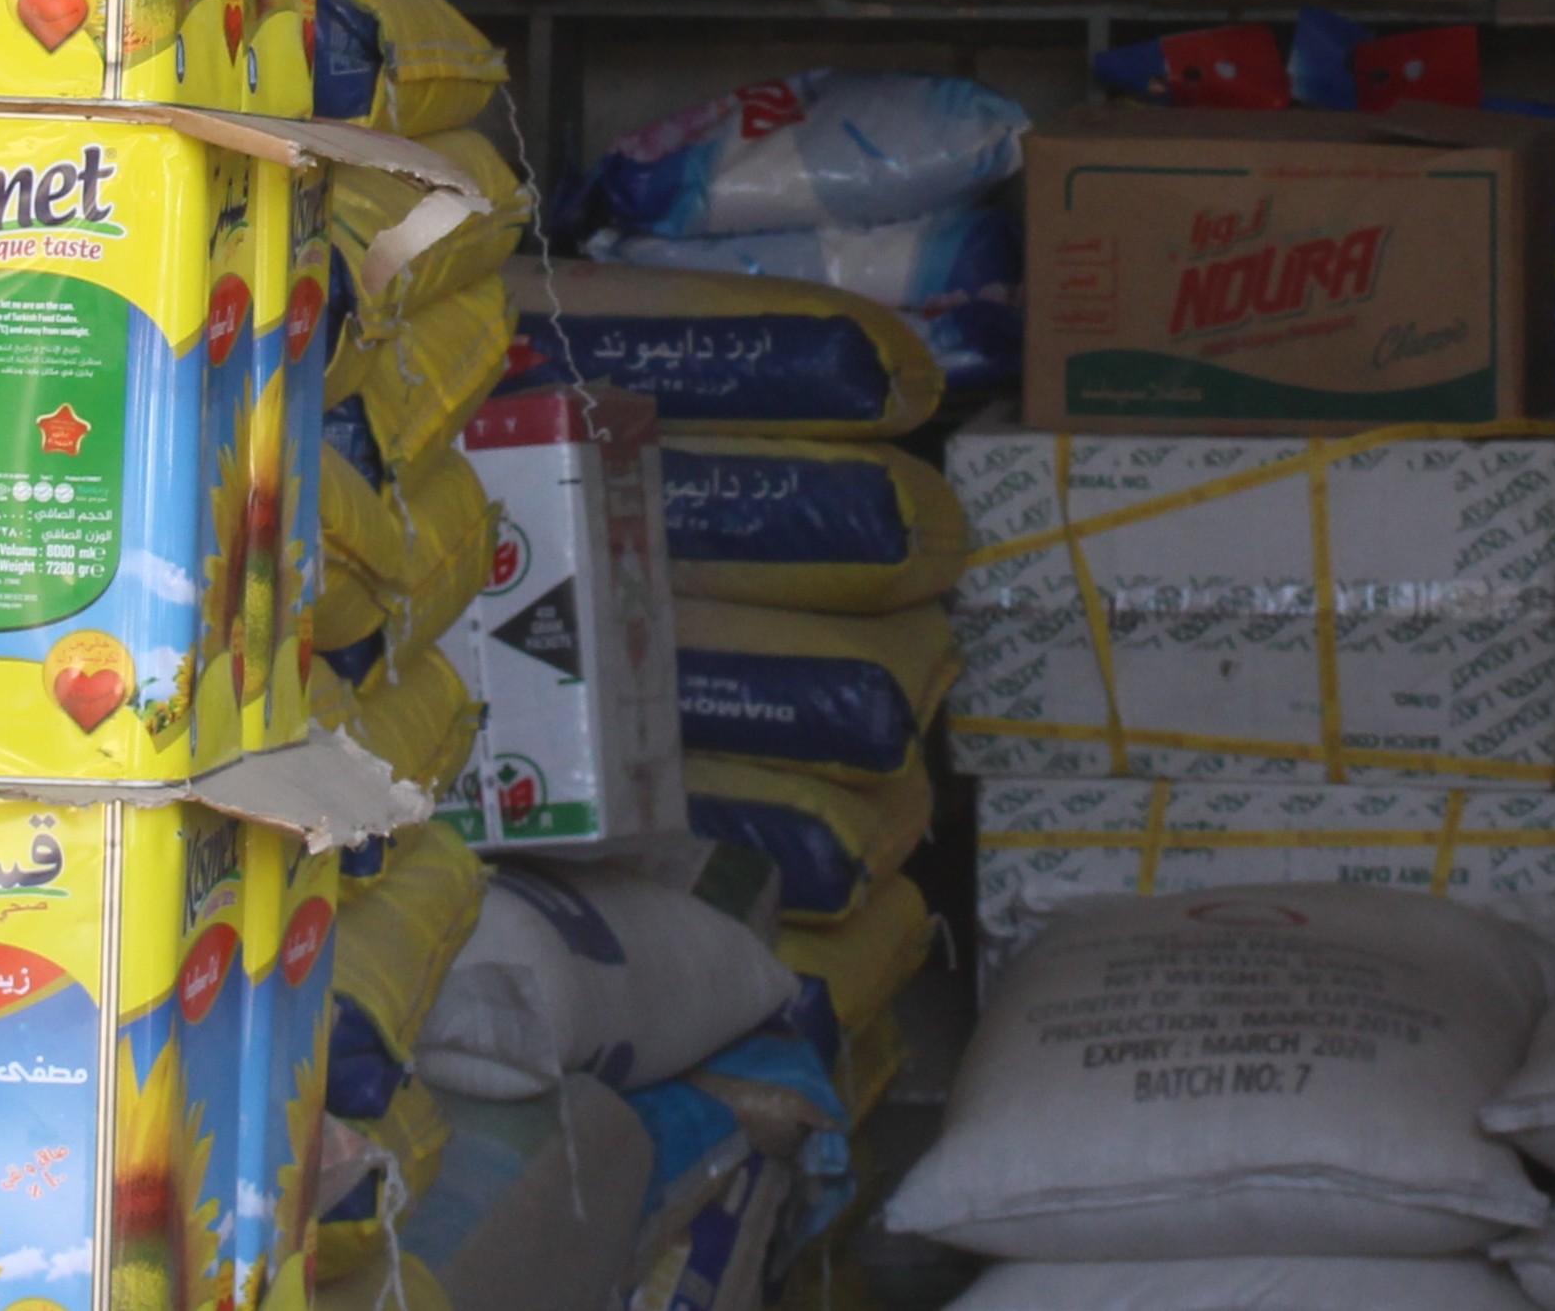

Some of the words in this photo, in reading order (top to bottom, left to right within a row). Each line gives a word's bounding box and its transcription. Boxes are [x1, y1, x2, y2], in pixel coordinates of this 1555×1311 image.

[43, 237, 102, 261] taste
[1169, 226, 1386, 336] NOURA
[593, 328, 715, 370] دايموند
[1082, 1037, 1174, 1068] EXPIRY
[1201, 1032, 1300, 1057] MARCH
[1135, 1064, 1226, 1102] BATCH
[1295, 1063, 1312, 1095] 7
